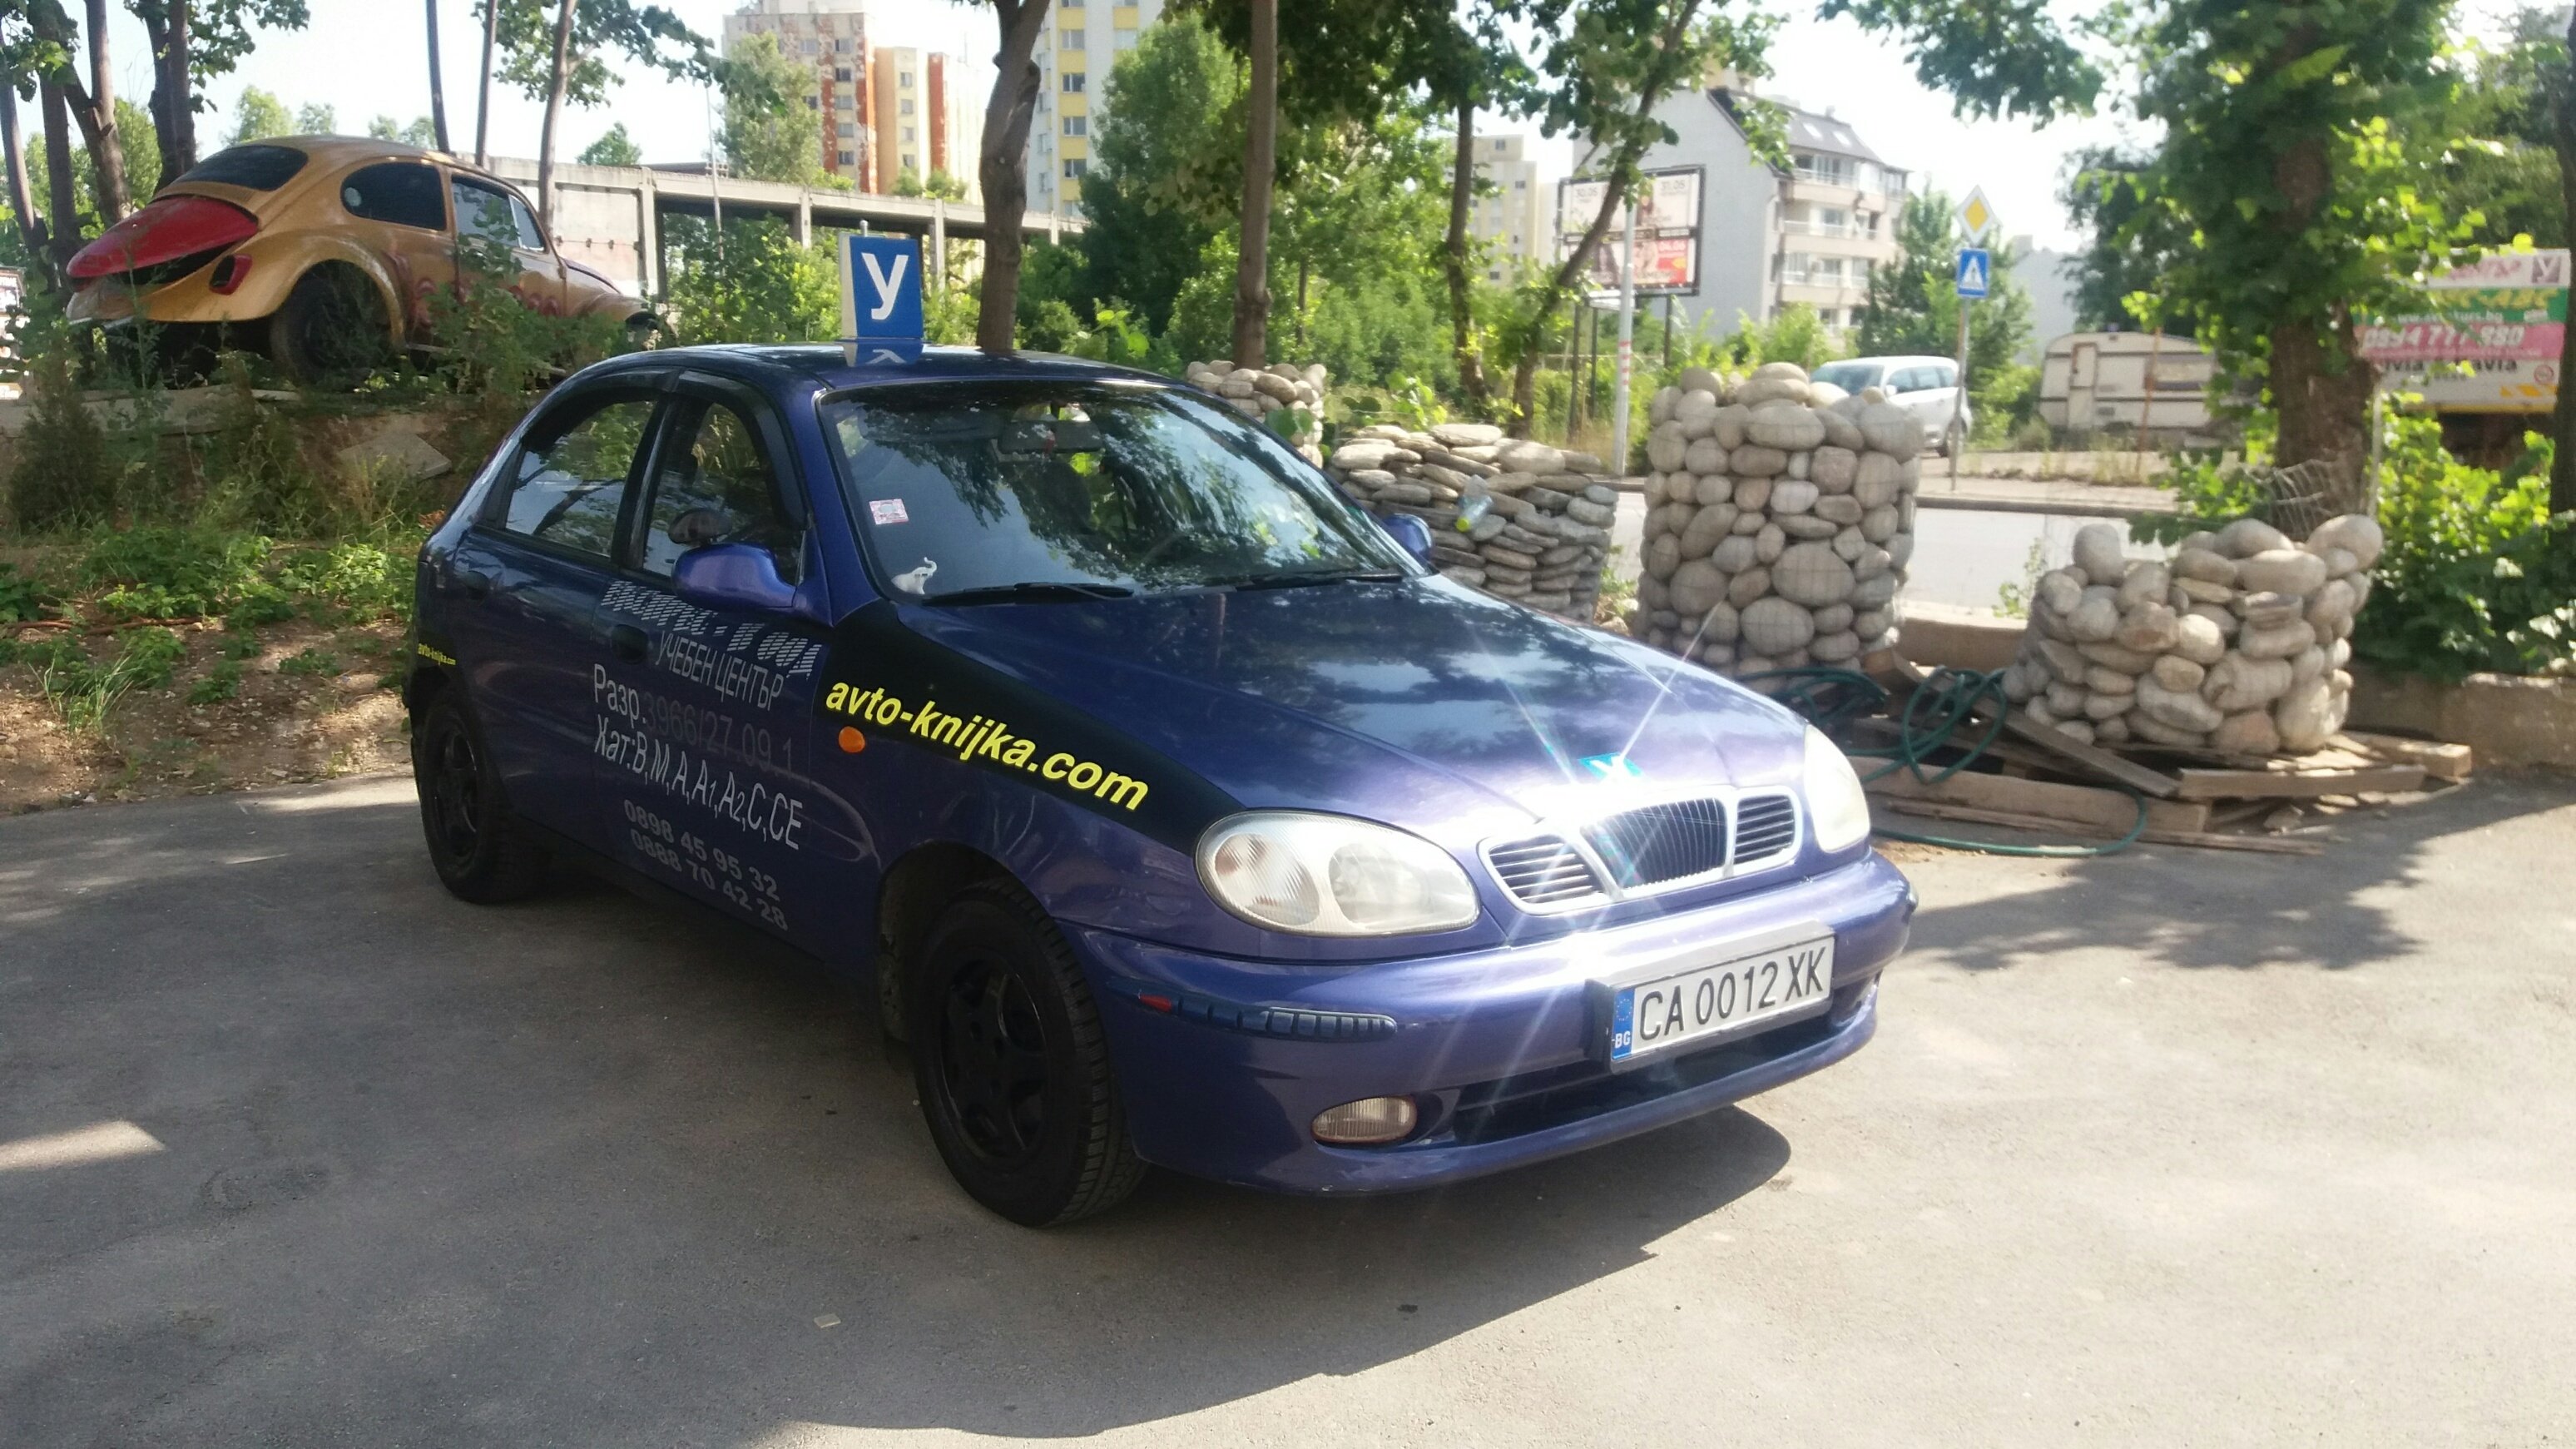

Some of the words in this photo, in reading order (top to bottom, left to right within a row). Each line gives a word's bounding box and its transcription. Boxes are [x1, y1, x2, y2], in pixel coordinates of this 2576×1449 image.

[655, 630, 717, 687] УЧЕБЕН
[714, 654, 785, 712] ЦЕНТЪР
[825, 681, 1149, 811] avto-knijka.com
[624, 799, 675, 844] 0898
[681, 831, 707, 861] 45
[713, 847, 743, 881] 95
[749, 866, 780, 902] 32
[631, 828, 682, 872] 0888
[686, 858, 716, 891] 70
[722, 880, 753, 911] 42
[755, 897, 789, 931] 28
[1613, 1030, 1632, 1050] BG
[1639, 984, 1685, 1041] CA
[1695, 960, 1779, 1026] 0012
[1784, 945, 1826, 1002] XK
